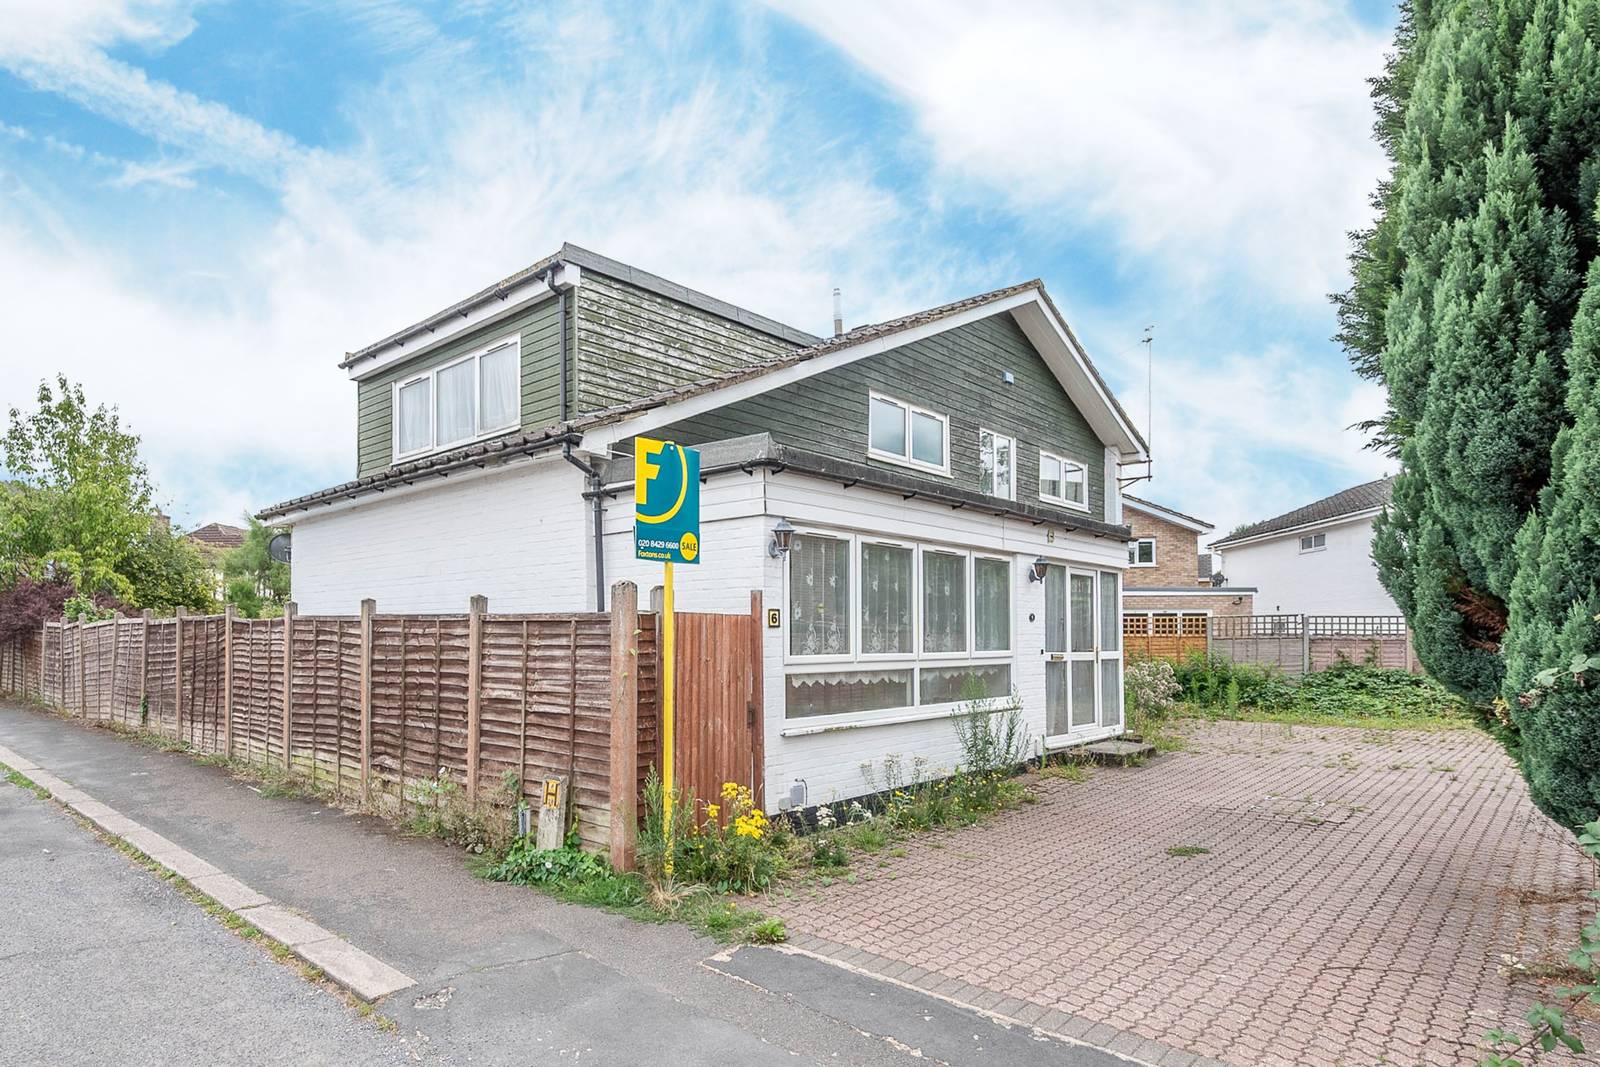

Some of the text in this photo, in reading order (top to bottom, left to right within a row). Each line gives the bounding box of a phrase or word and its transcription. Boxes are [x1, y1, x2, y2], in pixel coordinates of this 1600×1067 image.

[666, 542, 680, 550] 6600
[681, 542, 697, 552] SALE
[771, 613, 778, 624] 6
[545, 781, 559, 806] H
